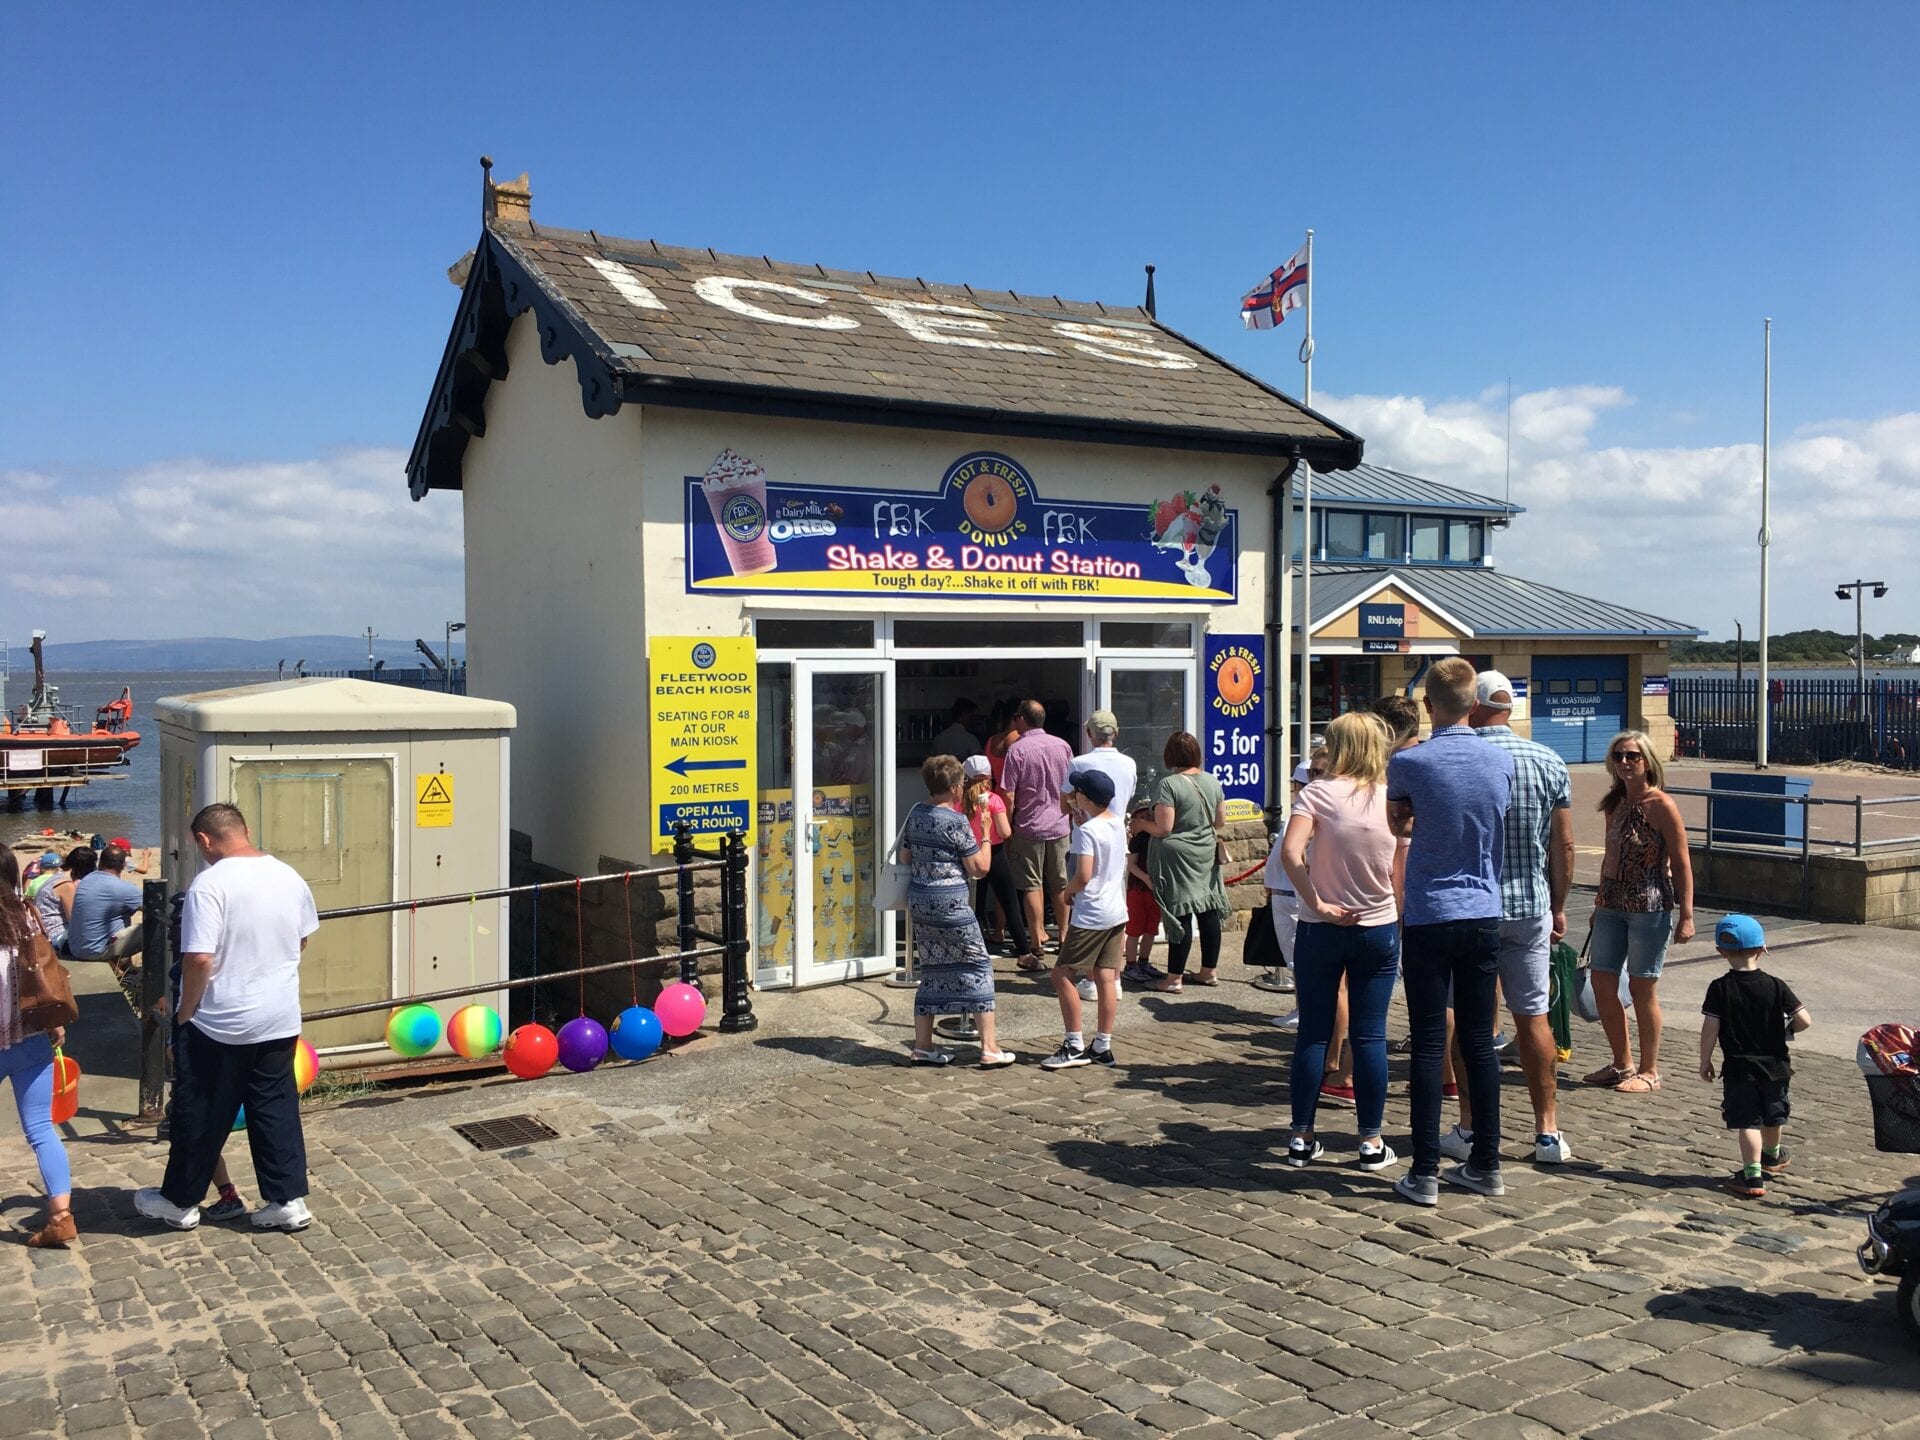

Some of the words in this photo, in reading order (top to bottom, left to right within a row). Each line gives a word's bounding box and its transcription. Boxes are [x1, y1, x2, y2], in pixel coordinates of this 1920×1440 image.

[584, 256, 1199, 370] ICES
[953, 464, 976, 489] HOT
[980, 461, 990, 472] &
[993, 462, 1027, 497] FRESH
[782, 506, 805, 519] Dairy
[805, 501, 823, 516] Milk
[873, 500, 935, 539] FBK
[1043, 510, 1098, 546] FBK
[769, 519, 837, 543] OREO
[958, 519, 1028, 548] DONUTS
[826, 543, 919, 571] Shake
[926, 545, 955, 570] &
[960, 545, 1044, 572] Donut
[1051, 550, 1141, 579] Station
[872, 573, 916, 589] Tough
[1007, 577, 1017, 589] it
[1020, 576, 1038, 590] off
[1041, 577, 1068, 591] with
[1072, 580, 1100, 592] FBK!
[1368, 616, 1384, 624] RNLI
[1386, 615, 1403, 627] shop
[1209, 649, 1227, 671] HOT
[1229, 646, 1237, 656] &
[1238, 647, 1262, 675] FRESH
[660, 673, 748, 682] FLEETWOOD
[656, 686, 705, 695] BEACH
[709, 685, 752, 694] KIOSK
[1213, 693, 1261, 718] DONUTS
[1560, 696, 1602, 704] COASTGUARD
[657, 711, 708, 721] SEATING
[711, 711, 735, 720] FOR
[737, 710, 750, 719] 48
[1552, 708, 1570, 716] KEEP
[1572, 707, 1596, 716] CLEAR
[683, 724, 697, 734] AT
[701, 723, 726, 733] OUR
[670, 737, 700, 747] MAIN
[703, 736, 738, 746] KIOSK
[1213, 729, 1225, 756] 5
[1230, 727, 1260, 756] for
[1212, 762, 1260, 786] £3.50
[670, 785, 690, 795] 200
[692, 782, 740, 794] METRES
[676, 806, 709, 818] OPEN
[711, 805, 734, 816] ALL
[667, 820, 699, 831] YR
[702, 817, 743, 829] ROUND
